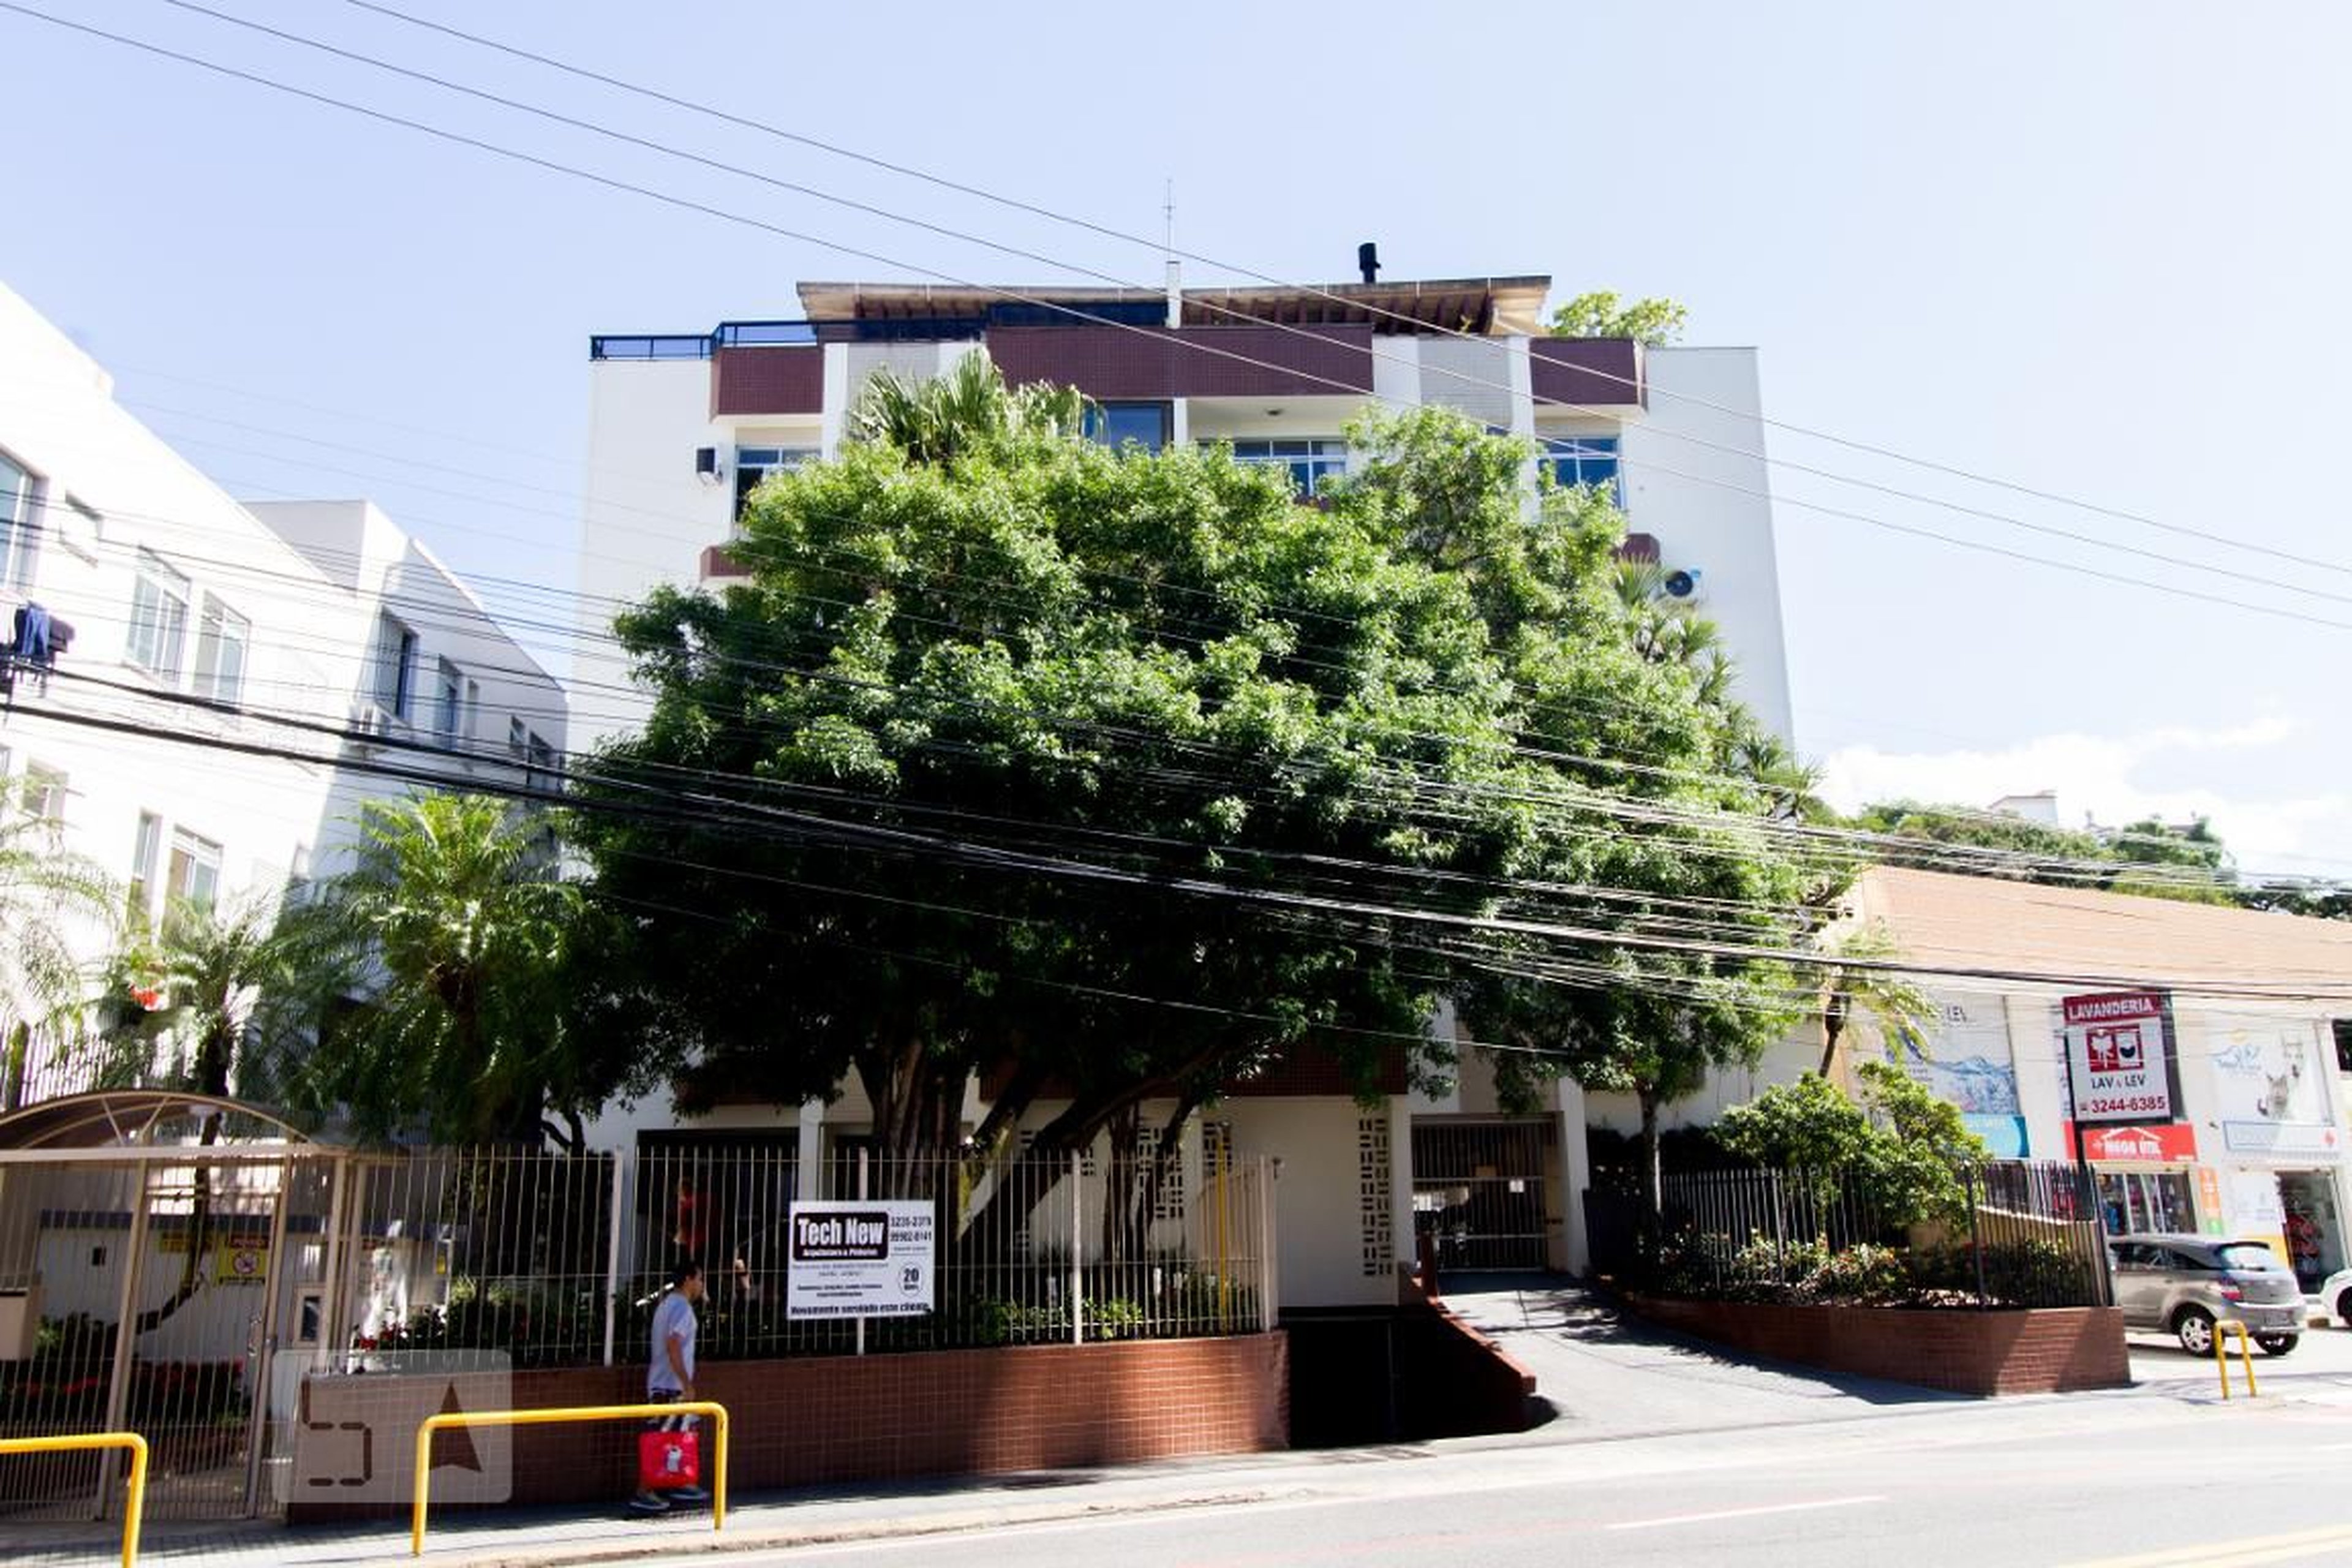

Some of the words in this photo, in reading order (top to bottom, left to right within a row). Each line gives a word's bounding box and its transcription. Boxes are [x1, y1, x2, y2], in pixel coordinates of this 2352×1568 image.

[2068, 997, 2154, 1019] LAVANDERIA
[2091, 1077, 2113, 1089] LAV
[2125, 1075, 2146, 1087] LEV
[2092, 1096, 2166, 1114] 3244-6385
[798, 1216, 842, 1245] Tech
[845, 1216, 884, 1245] New
[903, 1267, 919, 1283] 20
